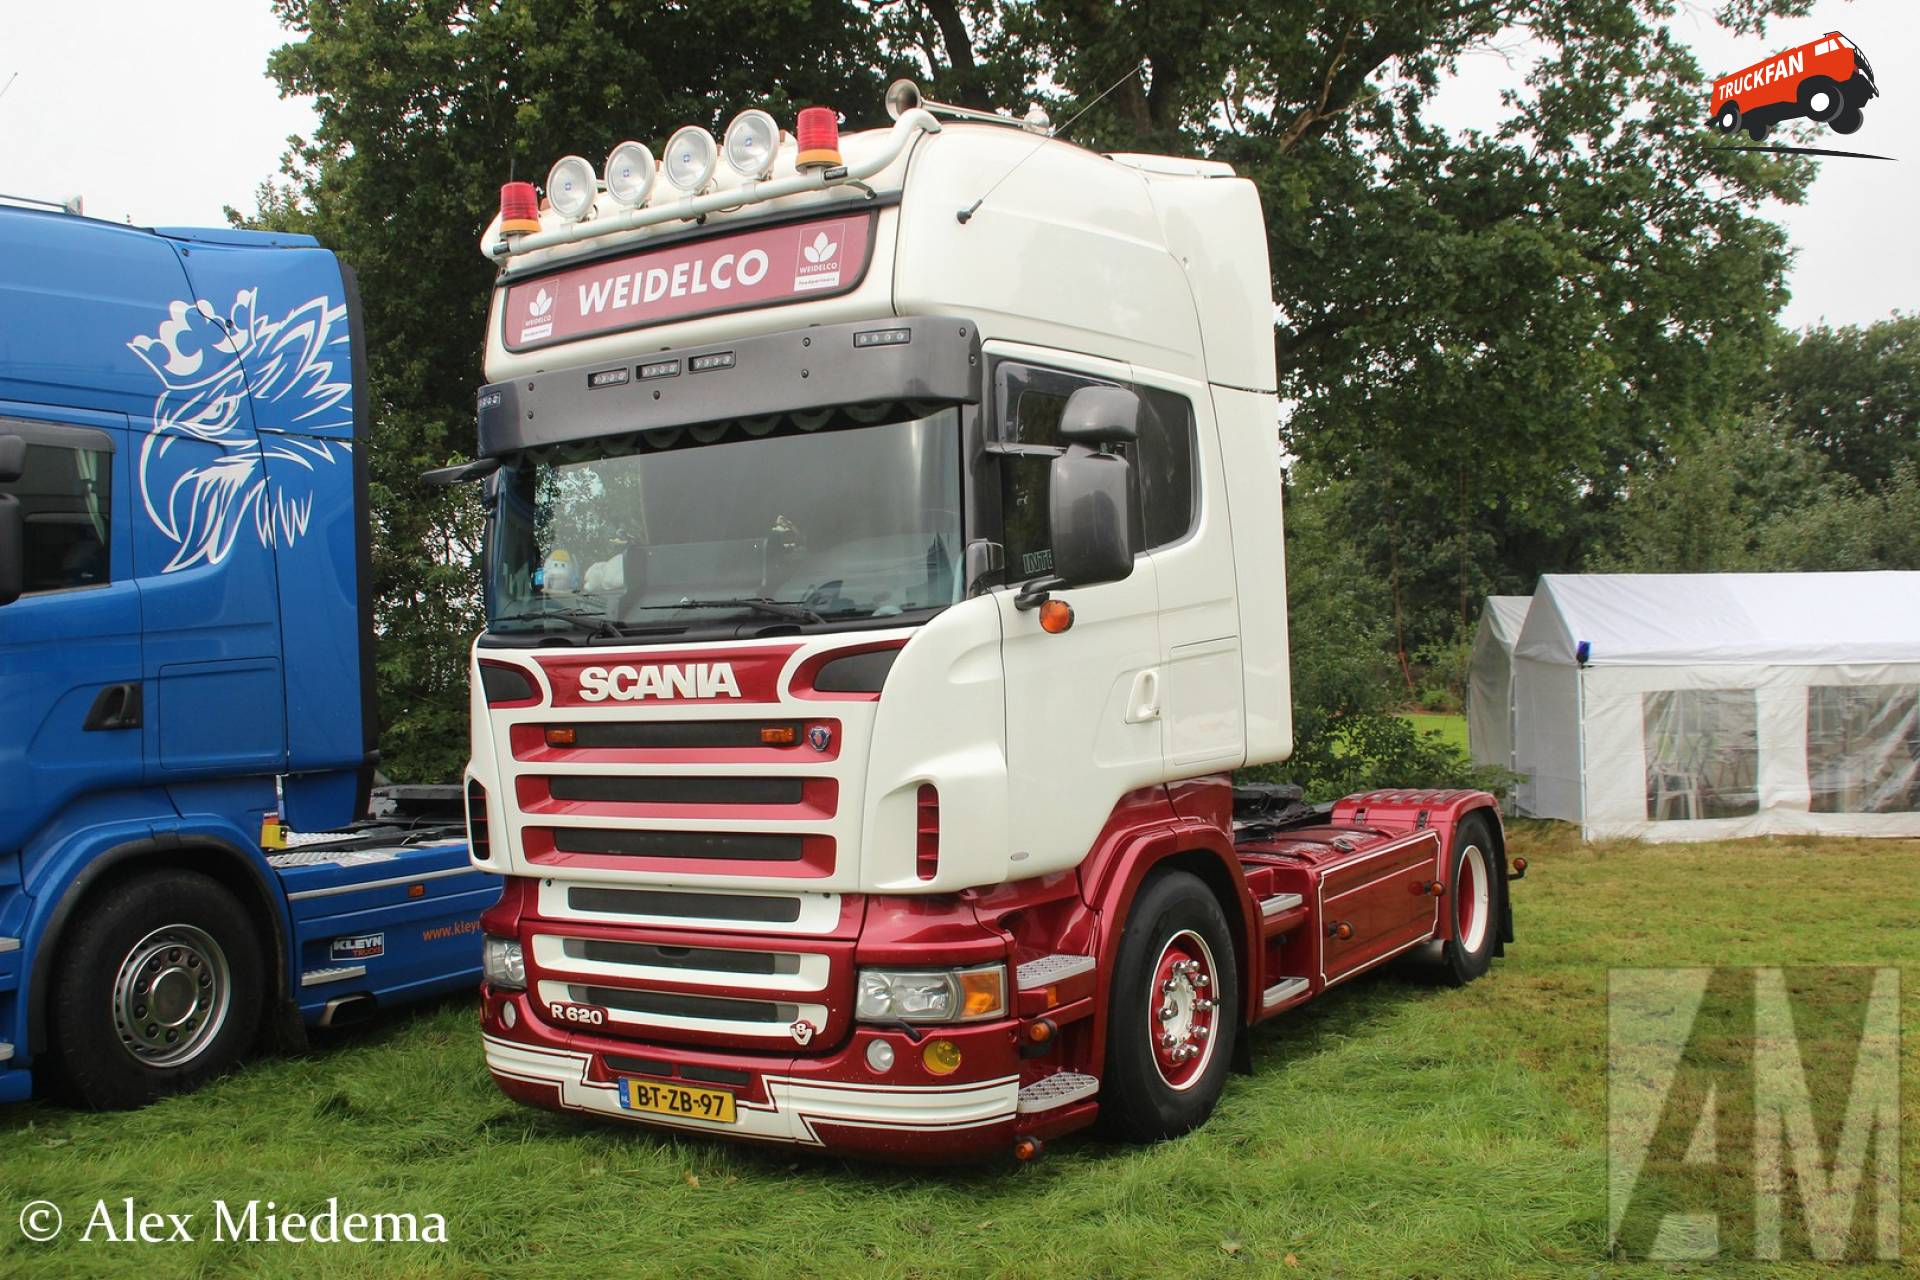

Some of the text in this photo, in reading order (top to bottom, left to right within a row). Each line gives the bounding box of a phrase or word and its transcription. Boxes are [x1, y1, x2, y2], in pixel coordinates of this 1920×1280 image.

[799, 262, 838, 274] WEIDELCO
[578, 248, 769, 317] WEIDELCO
[578, 662, 742, 702] SCANIA
[333, 935, 382, 950] KLEYN
[352, 946, 383, 957] TRUCKS
[551, 1004, 603, 1025] R 620
[637, 1084, 726, 1117] BT-ZB-97
